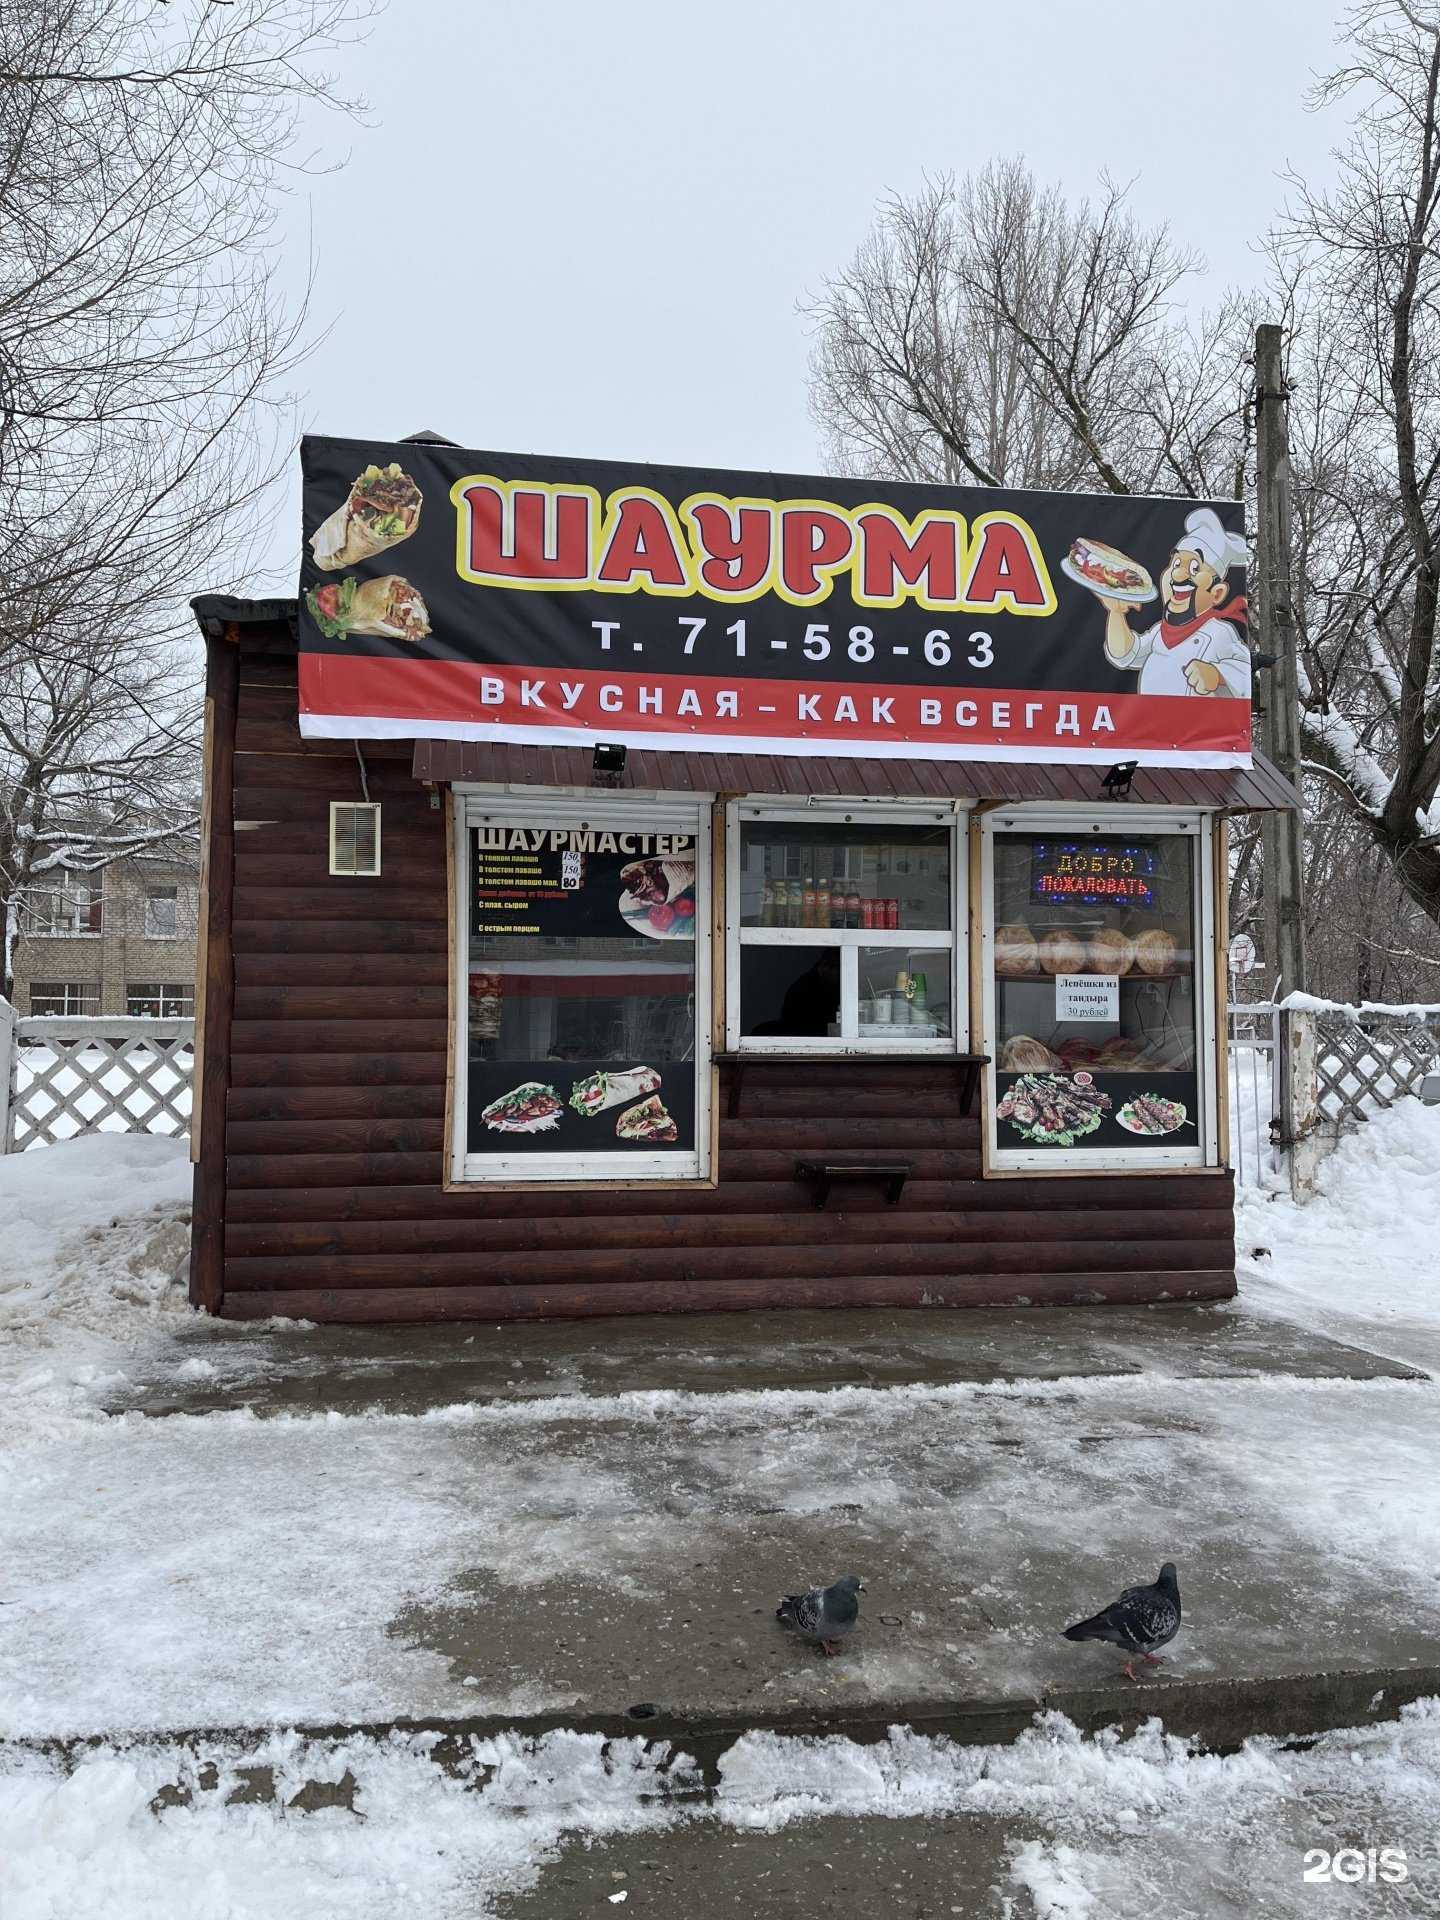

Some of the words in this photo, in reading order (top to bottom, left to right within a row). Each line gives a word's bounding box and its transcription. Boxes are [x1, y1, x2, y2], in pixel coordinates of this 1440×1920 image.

[456, 479, 1052, 611] ШАУРМА
[678, 616, 995, 668] 71-58-63
[480, 677, 738, 717] ВКУСНАЯ
[797, 693, 896, 725] КАК
[919, 699, 1116, 736] ВСЕГДА
[477, 827, 690, 855] ШАУРМАСТЕР
[484, 866, 514, 874] толстом
[1057, 855, 1134, 874] ДОБРО
[484, 878, 514, 886] толстом
[563, 877, 577, 888] 80
[1039, 875, 1148, 895] ПОЖАЛОВАТЬ
[1060, 978, 1104, 989] Лепёшки
[1068, 994, 1109, 1004] тандыра
[1080, 1007, 1109, 1017] рублей
